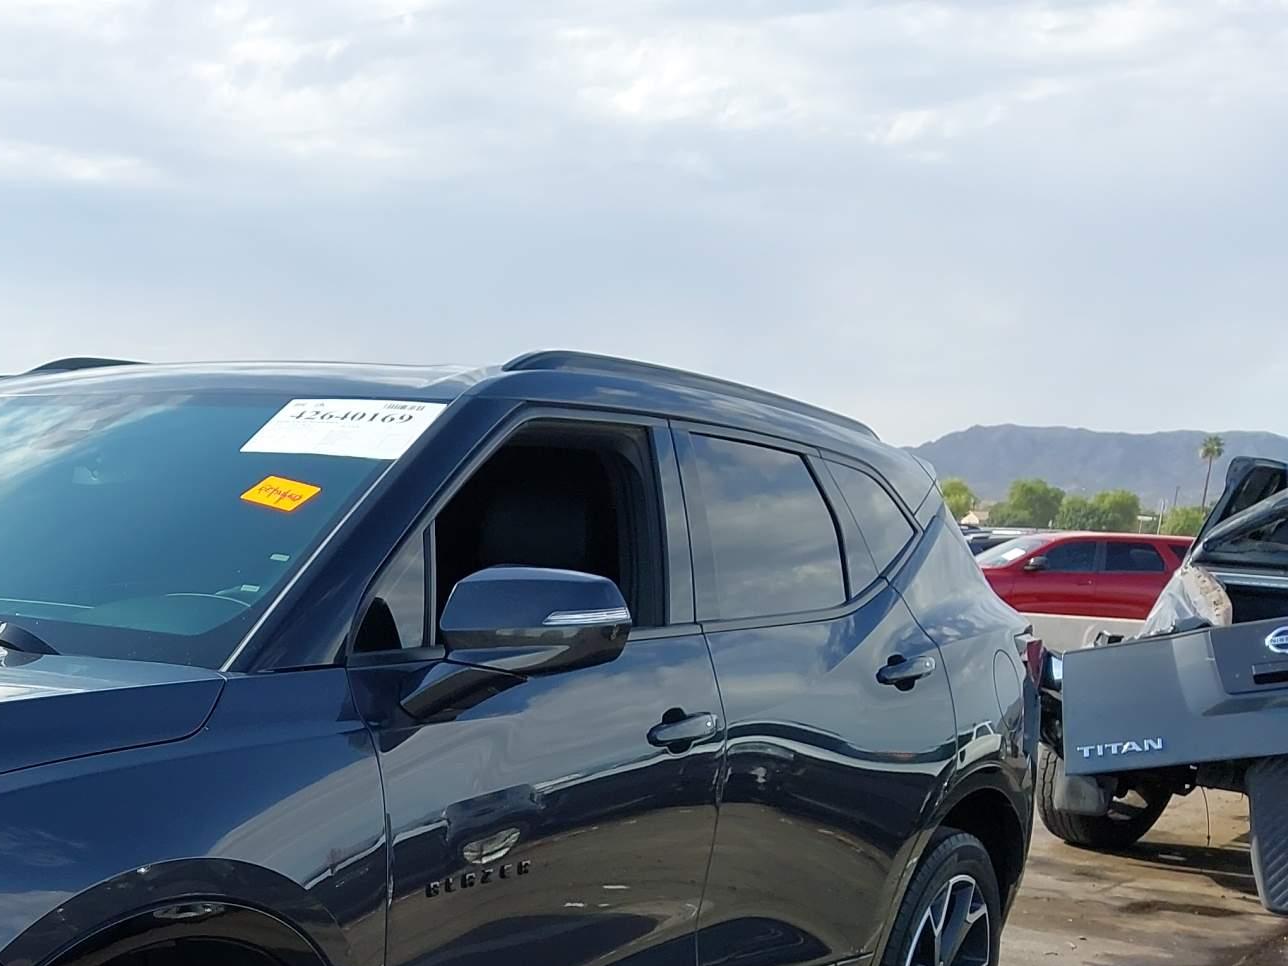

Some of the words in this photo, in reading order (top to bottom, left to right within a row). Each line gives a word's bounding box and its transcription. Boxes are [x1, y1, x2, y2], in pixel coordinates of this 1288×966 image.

[290, 410, 414, 424] 42640169
[1077, 737, 1164, 758] TITAN
[425, 860, 531, 898] BLAZER
